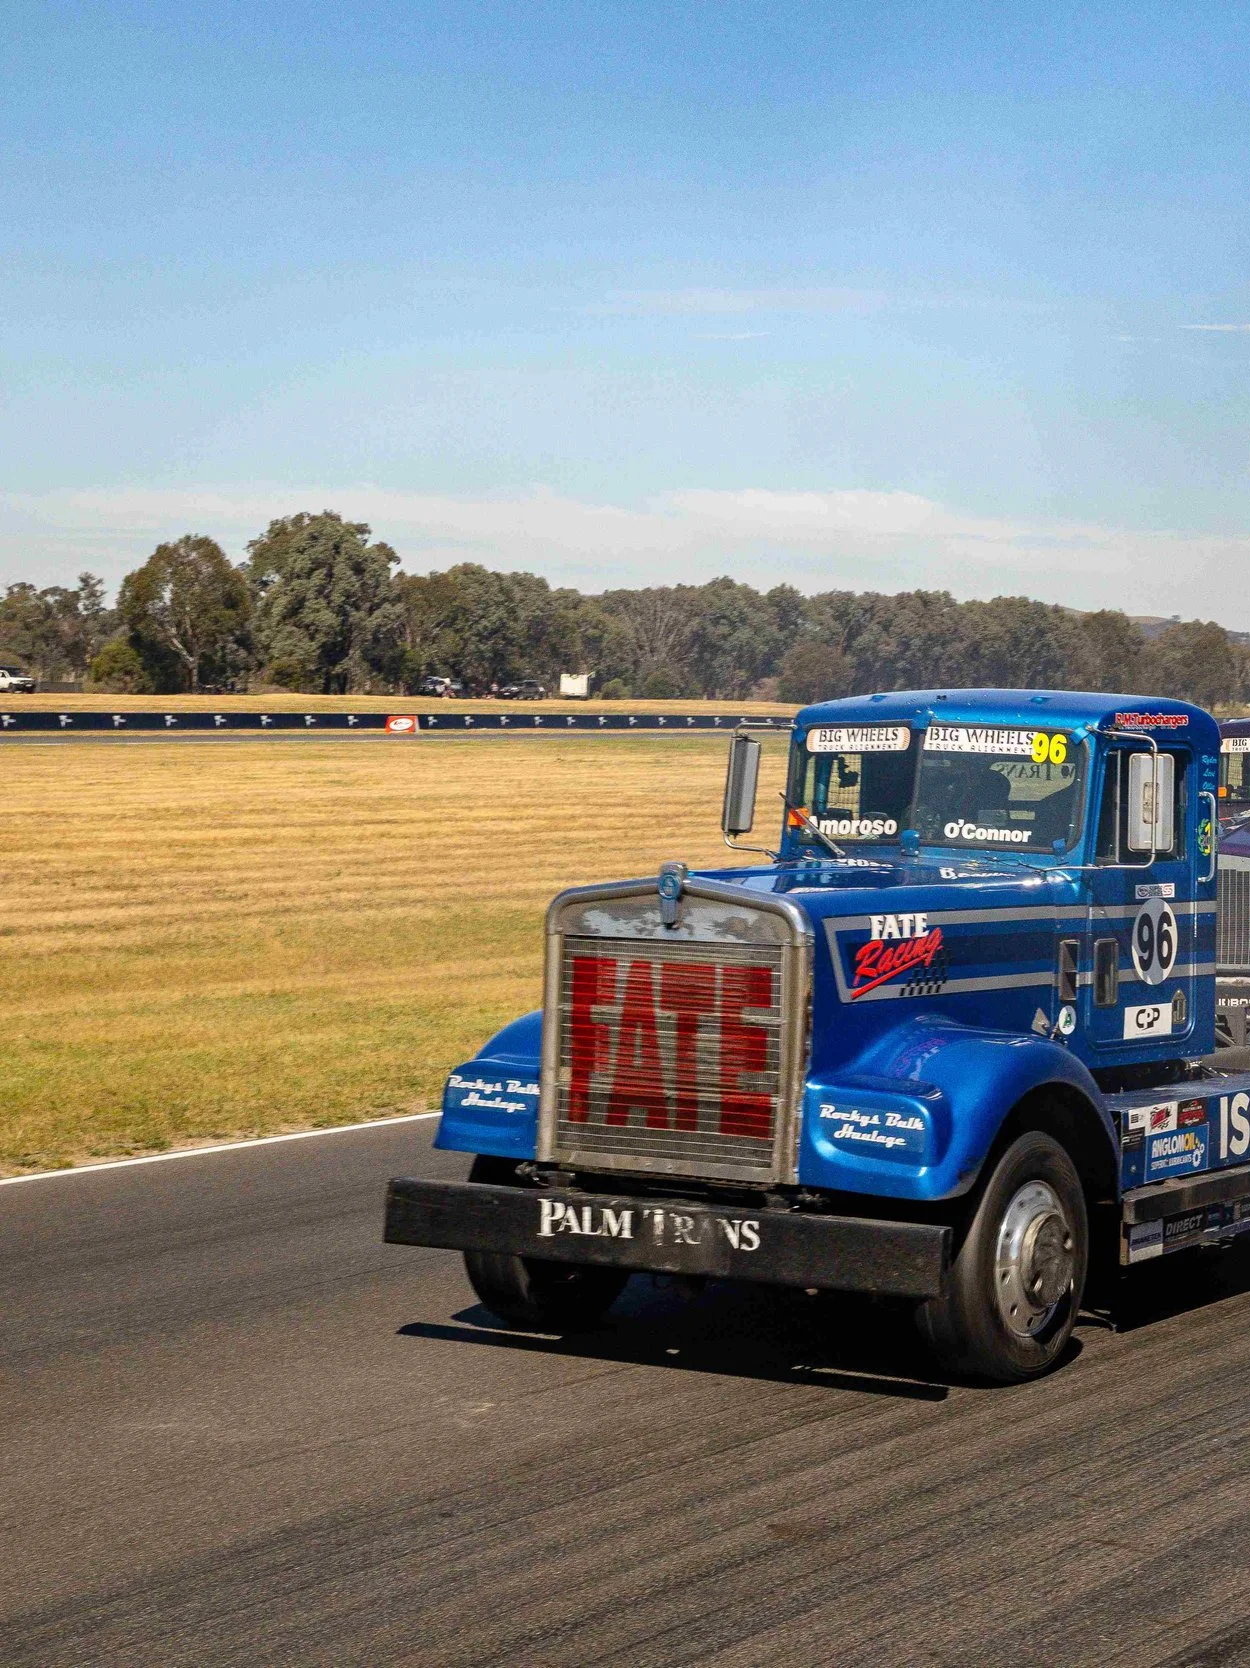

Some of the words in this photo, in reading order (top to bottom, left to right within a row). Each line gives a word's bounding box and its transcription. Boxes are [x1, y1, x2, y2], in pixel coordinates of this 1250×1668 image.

[819, 729, 841, 743] BIG
[847, 728, 899, 742] WHEELS
[929, 728, 959, 742] BIG
[965, 729, 1034, 745] WHEELS
[929, 743, 963, 751] TRUCK
[970, 744, 1033, 754] ALIGNMENT
[1031, 732, 1068, 764] 96
[1232, 738, 1247, 747] BIG
[805, 815, 897, 837] Amoroso
[943, 819, 1033, 843] O'Connor
[869, 913, 929, 940] FATE
[1137, 911, 1173, 972] 96
[852, 927, 944, 987] Racing
[568, 956, 773, 1140] FATE
[819, 1104, 881, 1127] Rockys
[885, 1112, 926, 1131] Bulk
[833, 1123, 907, 1149] Haulage
[1151, 1132, 1195, 1159] ANGLOMOIL
[536, 1198, 634, 1239] PALM
[1164, 1214, 1204, 1237] DIRECT
